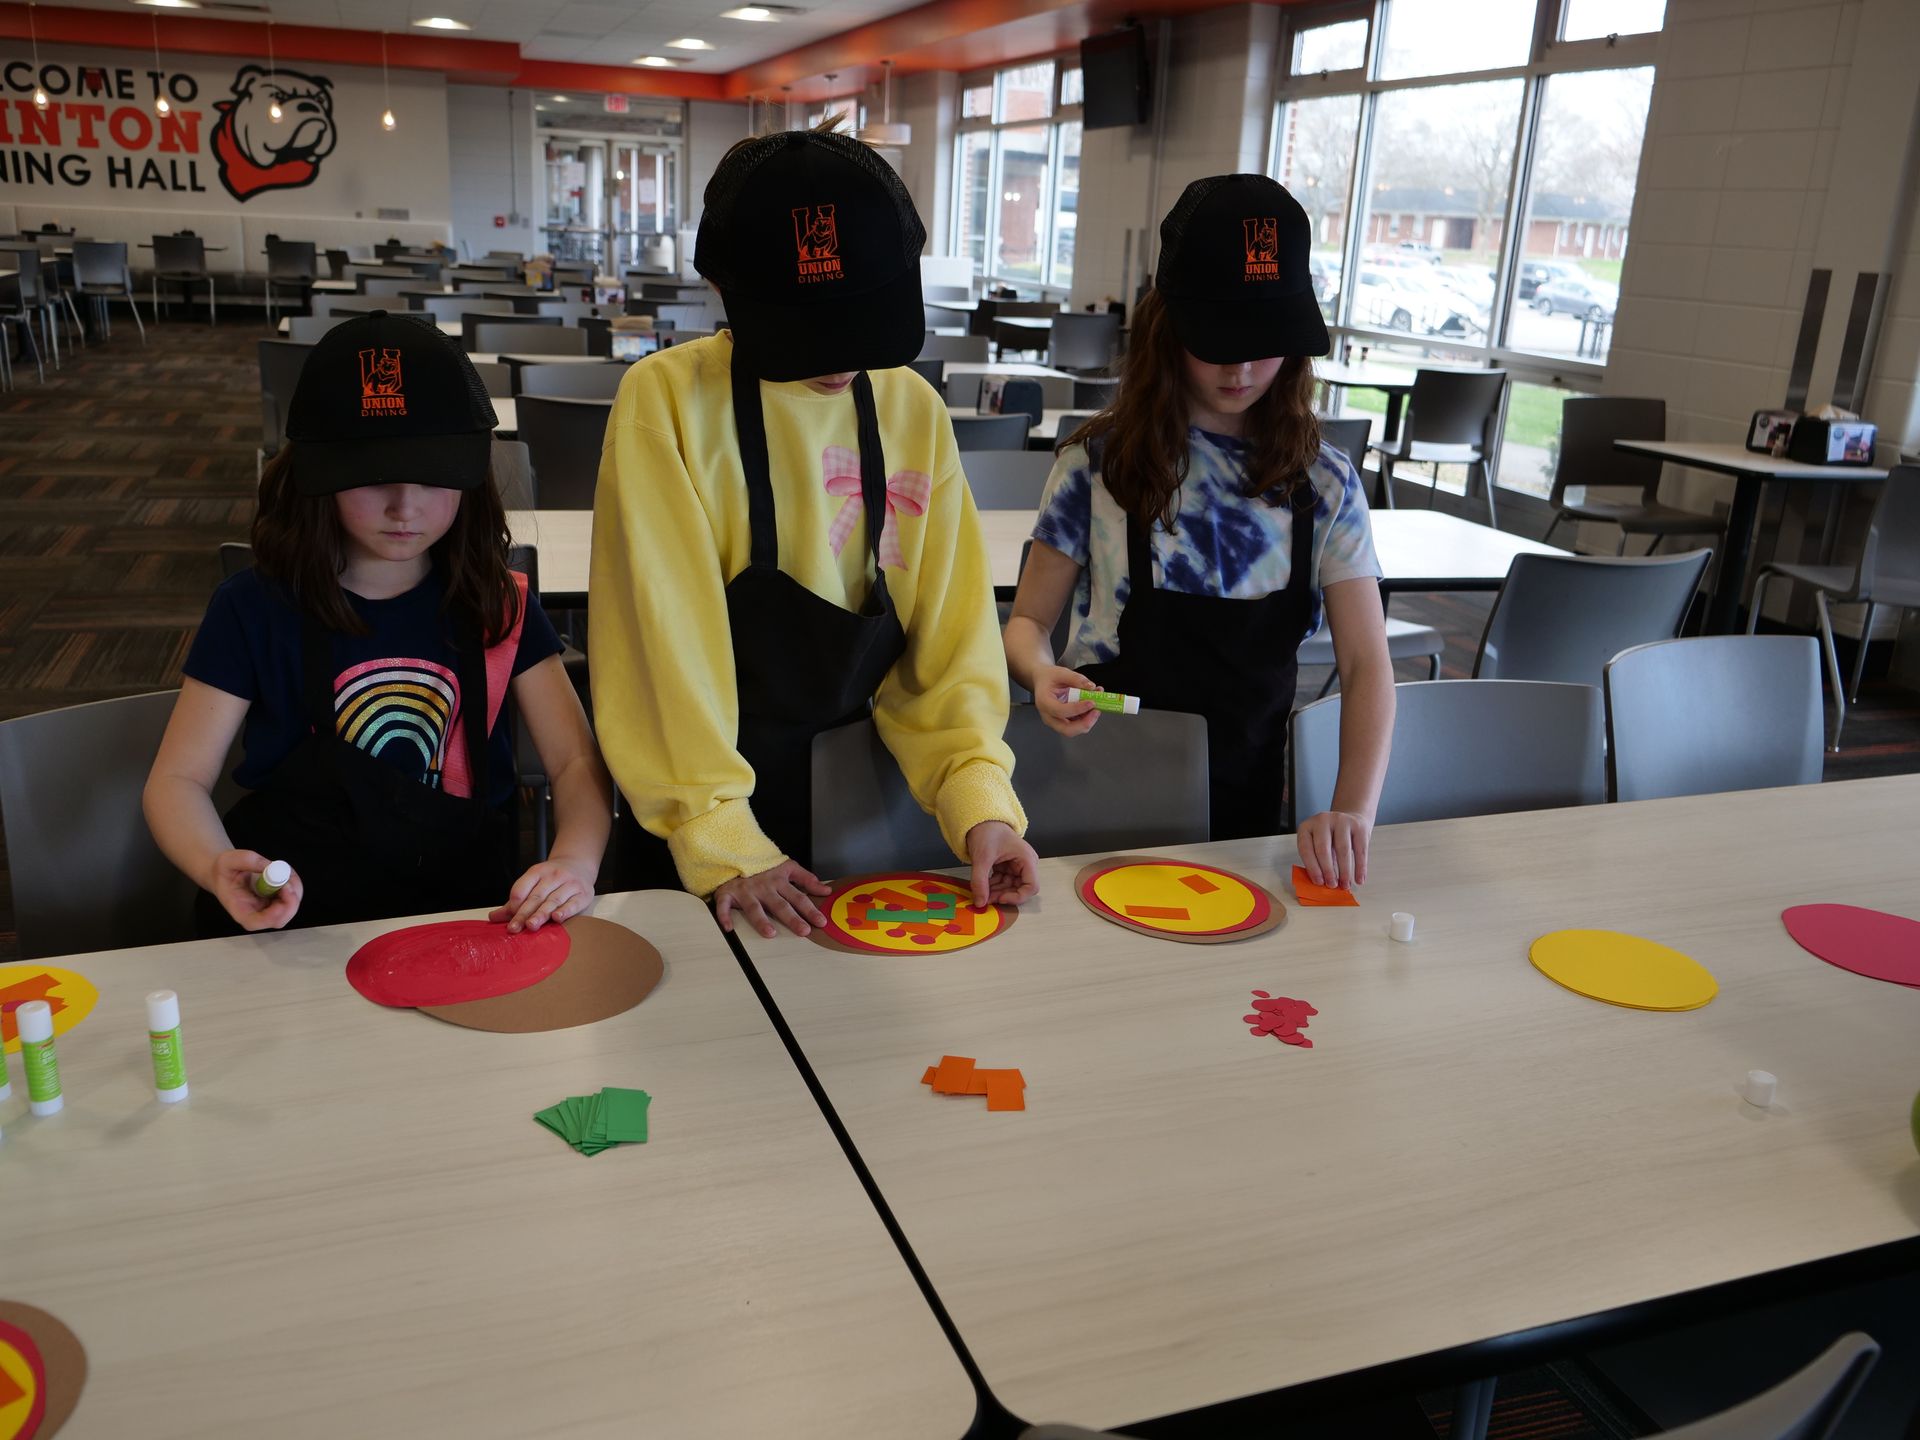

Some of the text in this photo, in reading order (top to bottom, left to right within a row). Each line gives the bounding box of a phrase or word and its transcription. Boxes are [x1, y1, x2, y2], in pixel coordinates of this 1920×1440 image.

[0, 62, 198, 102] COME TO
[0, 150, 206, 192] ING HALL
[798, 259, 841, 275] UNION
[1246, 263, 1279, 274] UNION
[798, 271, 845, 284] DINING
[1244, 274, 1280, 282] DINING
[362, 397, 405, 409] UNION
[361, 408, 408, 417] DINING
